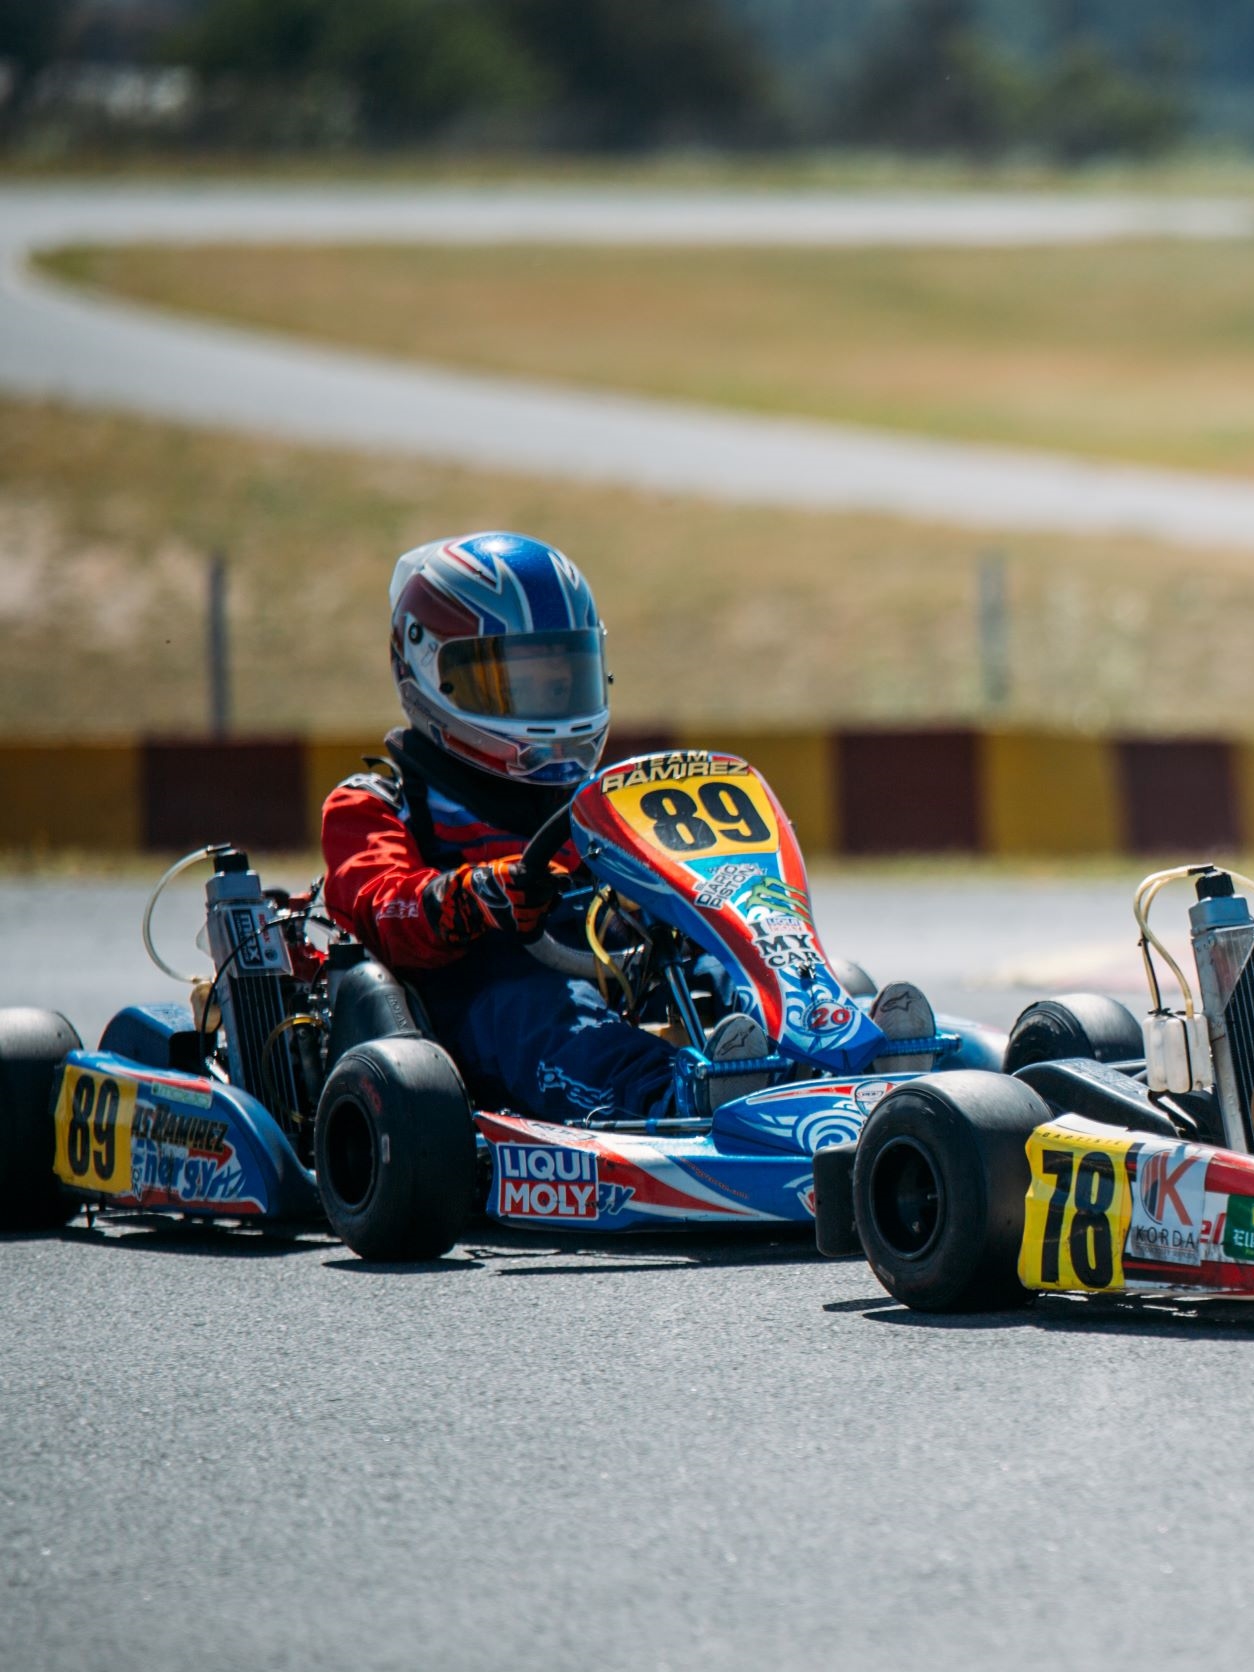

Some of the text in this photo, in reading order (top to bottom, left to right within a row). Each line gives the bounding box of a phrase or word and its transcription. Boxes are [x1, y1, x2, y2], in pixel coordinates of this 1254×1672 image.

[635, 750, 708, 769] TEAM
[602, 761, 749, 793] RAMIREZ
[640, 782, 771, 852] 89
[696, 864, 739, 906] DIARIO
[710, 865, 756, 908] PISTON
[755, 934, 811, 956] MY
[768, 951, 822, 967] CAR
[811, 1007, 851, 1029] 20
[68, 1074, 121, 1181] 89
[503, 1149, 592, 1181] LIQUI
[504, 1182, 595, 1216] MOLY
[1041, 1150, 1115, 1288] 78
[1135, 1225, 1196, 1249] KORDA
